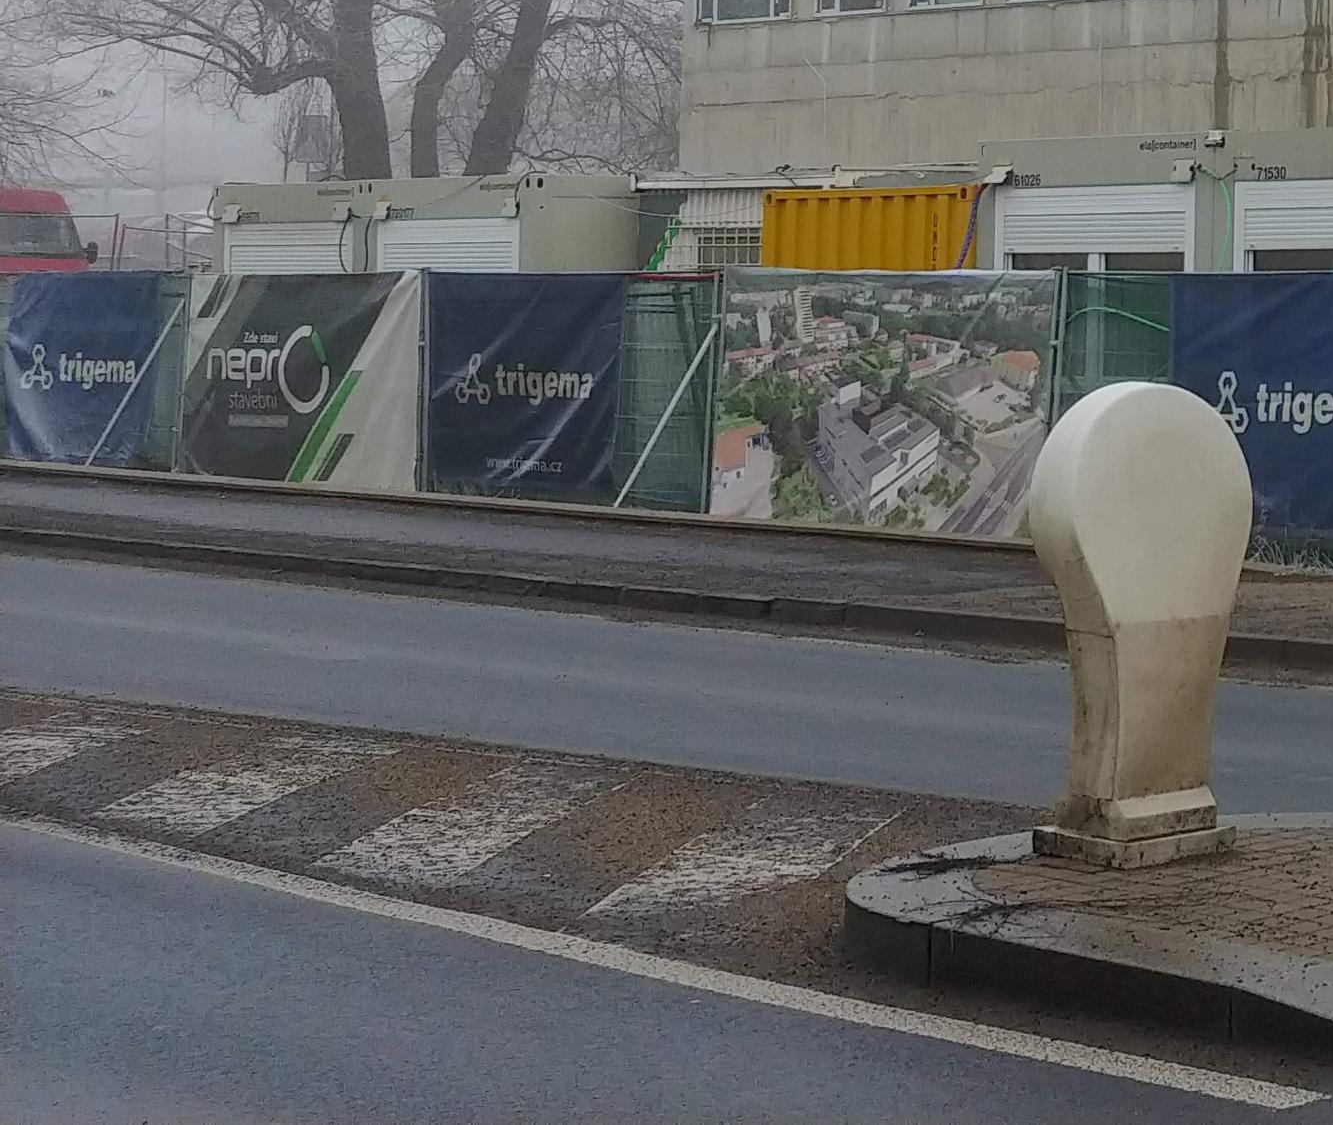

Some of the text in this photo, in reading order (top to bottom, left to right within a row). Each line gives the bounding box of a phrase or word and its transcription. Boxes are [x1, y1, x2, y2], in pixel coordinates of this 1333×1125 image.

[1256, 166, 1287, 181] 71530
[59, 352, 137, 390] trigema
[495, 363, 594, 405] trigema
